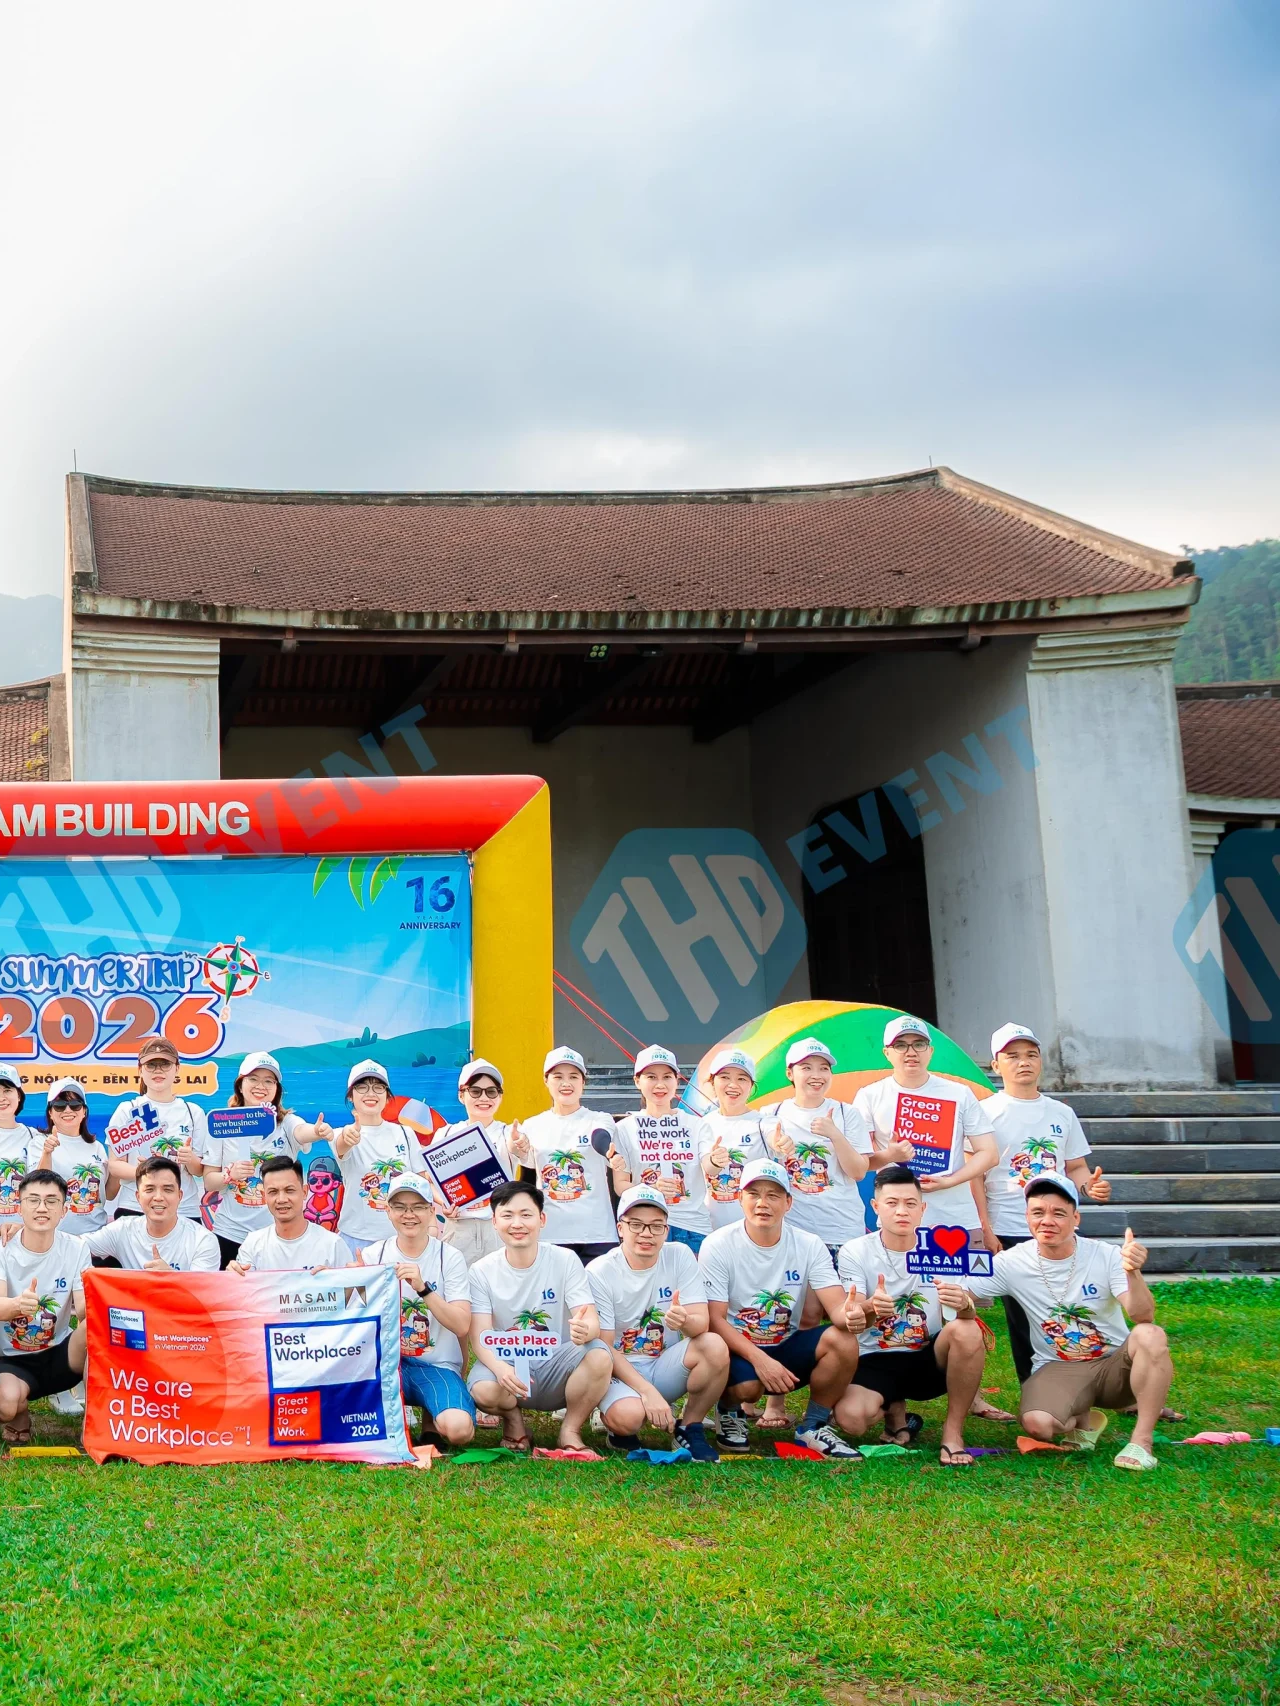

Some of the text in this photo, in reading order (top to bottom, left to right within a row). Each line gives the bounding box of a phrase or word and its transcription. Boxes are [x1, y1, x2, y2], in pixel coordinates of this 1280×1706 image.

[55, 801, 251, 837] BUILDING
[406, 875, 455, 913] 16
[399, 921, 462, 929] ANNIVERSARY
[140, 957, 196, 989] TRIP
[103, 1073, 128, 1084] BỀN
[186, 1075, 207, 1084] LAI
[901, 1096, 941, 1111] Great
[900, 1106, 940, 1122] Place
[636, 1117, 679, 1127] We did
[899, 1117, 914, 1128] To
[108, 1119, 144, 1145] Best
[638, 1128, 690, 1139] the work
[1050, 1124, 1062, 1133] 16
[272, 1137, 284, 1147] 16
[578, 1135, 589, 1143] 16
[741, 1134, 751, 1142] 16
[395, 1144, 405, 1153] 16
[639, 1140, 673, 1150] We're
[679, 1140, 690, 1148] 16
[429, 1150, 447, 1162] Best
[641, 1151, 694, 1161] not done
[480, 1171, 502, 1184] VIETNAM
[489, 1178, 505, 1188] 2026
[444, 1179, 461, 1189] Great
[447, 1185, 462, 1194] Place
[918, 1230, 929, 1250] I
[908, 1254, 963, 1266] MASAN
[785, 1270, 800, 1281] 16
[920, 1274, 934, 1283] 16
[55, 1277, 66, 1288] 16
[542, 1288, 555, 1300] 16
[658, 1287, 672, 1298] 16
[1081, 1284, 1097, 1296] 16
[279, 1291, 337, 1305] MASAN
[308, 1305, 338, 1313] MATERIALS
[273, 1332, 306, 1345] Best
[484, 1335, 558, 1346] Great Place
[496, 1346, 549, 1357] To Work
[110, 1367, 193, 1398] We are
[277, 1396, 308, 1406] Great
[109, 1395, 180, 1420] a Best
[277, 1407, 308, 1415] Place
[277, 1417, 289, 1425] To
[340, 1411, 378, 1424] VIETNAM
[351, 1424, 380, 1437] 2026
